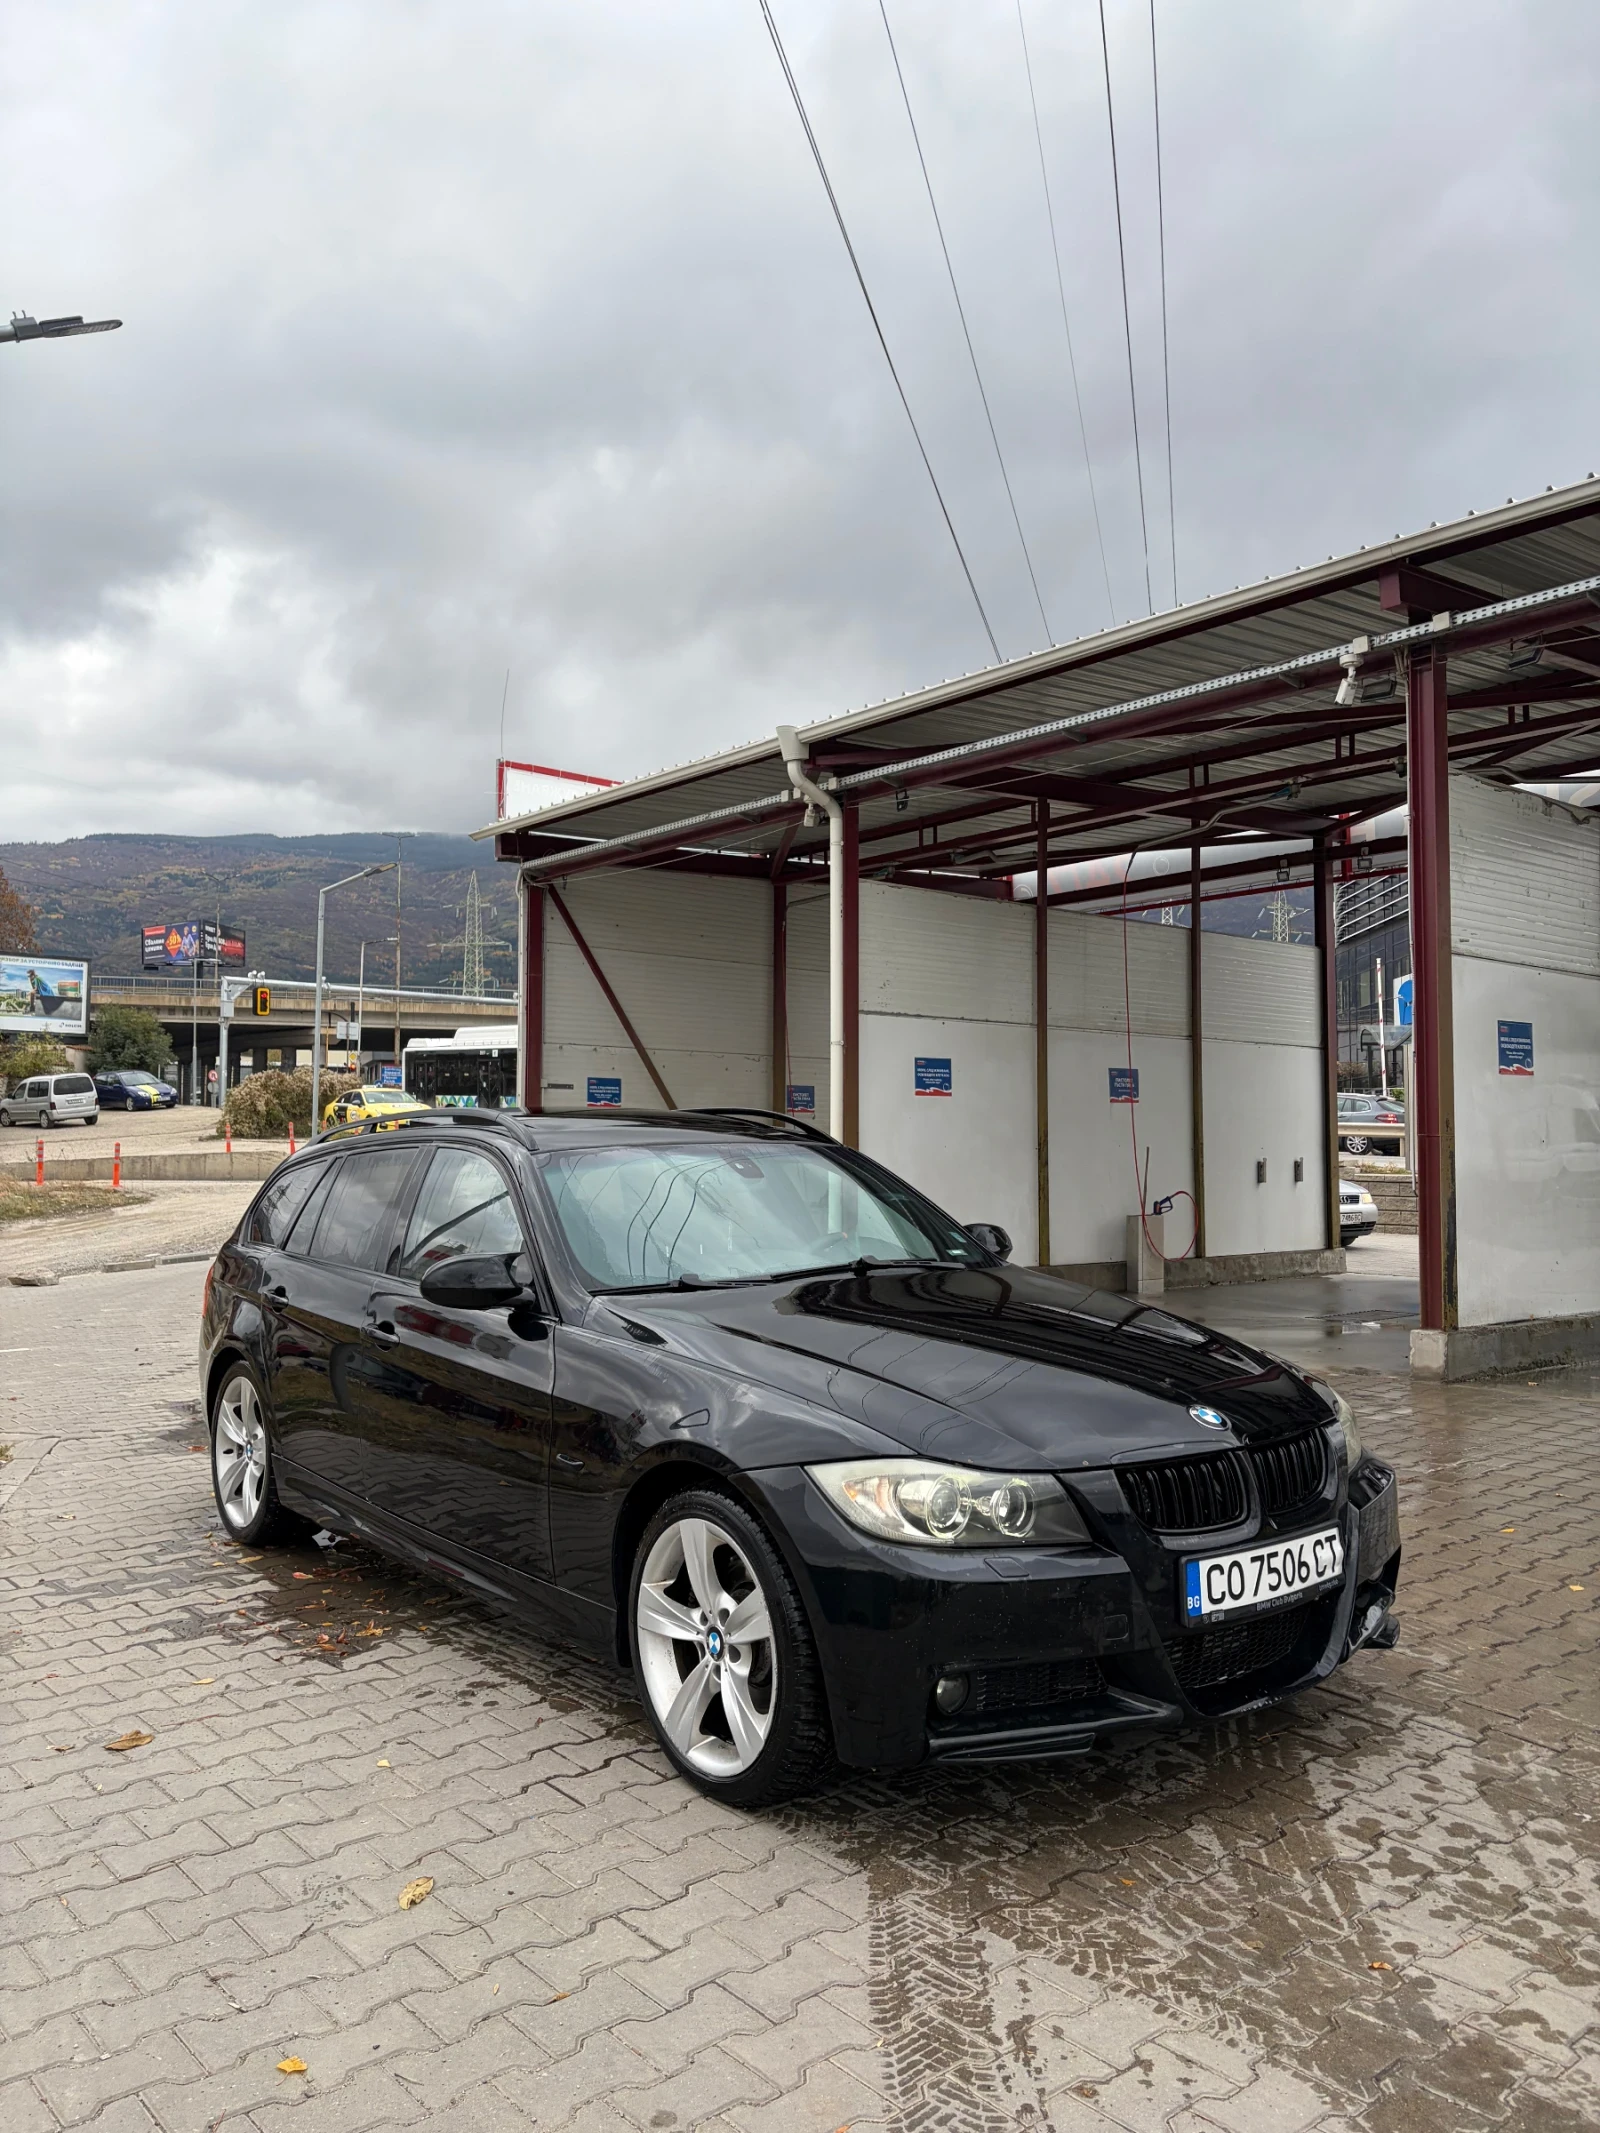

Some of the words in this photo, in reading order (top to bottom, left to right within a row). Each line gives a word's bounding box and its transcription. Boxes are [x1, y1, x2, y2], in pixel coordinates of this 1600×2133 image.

[1206, 1560, 1245, 1605] CO
[1250, 1544, 1311, 1597] 7506
[1312, 1534, 1337, 1578] CT
[1187, 1595, 1200, 1609] BG
[1256, 1599, 1272, 1611] BMW
[1272, 1597, 1284, 1607] Club
